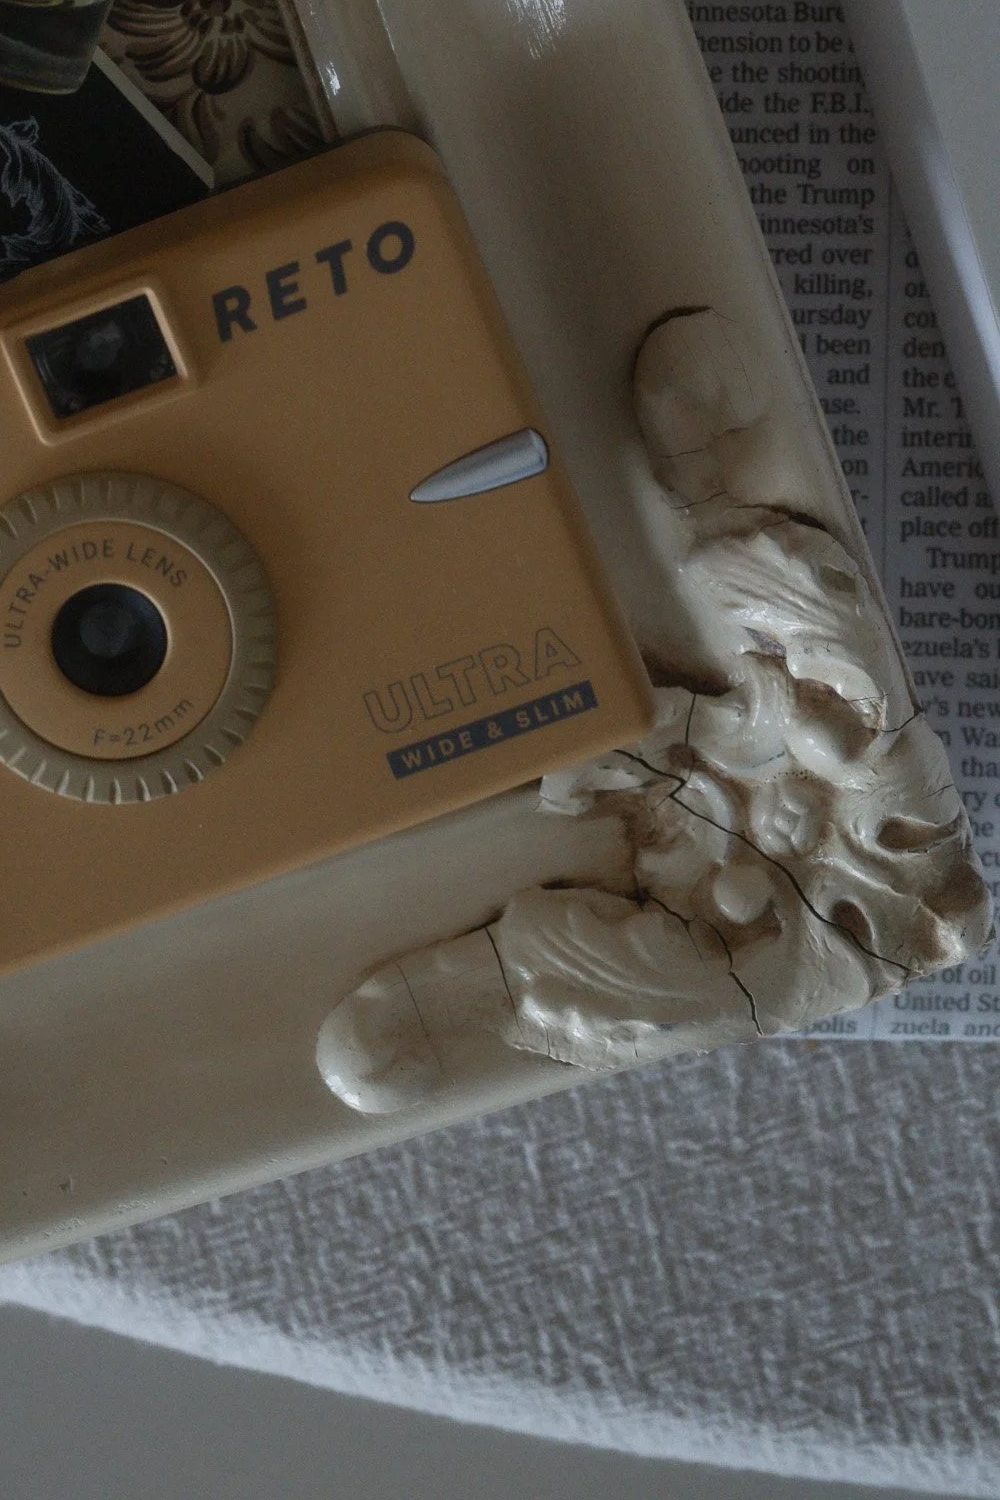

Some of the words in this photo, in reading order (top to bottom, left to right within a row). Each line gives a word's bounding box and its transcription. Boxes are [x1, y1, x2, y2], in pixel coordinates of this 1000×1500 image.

[788, 34, 811, 53] to
[815, 31, 844, 53] be
[730, 61, 770, 82] the
[762, 92, 800, 114] the
[808, 123, 831, 144] in
[838, 123, 876, 145] the
[846, 158, 876, 176] on
[797, 184, 876, 211] Trump
[821, 247, 873, 266] over
[211, 220, 416, 343] RETO
[793, 273, 874, 301] killing,
[816, 333, 871, 356] been
[826, 363, 871, 386] and
[902, 366, 940, 389] the
[902, 396, 941, 419] Mr.
[832, 424, 870, 447] the
[901, 485, 969, 508] called
[901, 515, 963, 543] place
[3, 537, 116, 650] ULTRA-WIDE
[125, 540, 190, 590] LENS
[900, 576, 956, 598] have
[362, 626, 584, 735] ULTRA
[400, 728, 475, 772] WIDE
[486, 719, 504, 741] &
[517, 689, 588, 730] SLIM
[967, 964, 997, 986] oil
[890, 1017, 951, 1037] zuela
